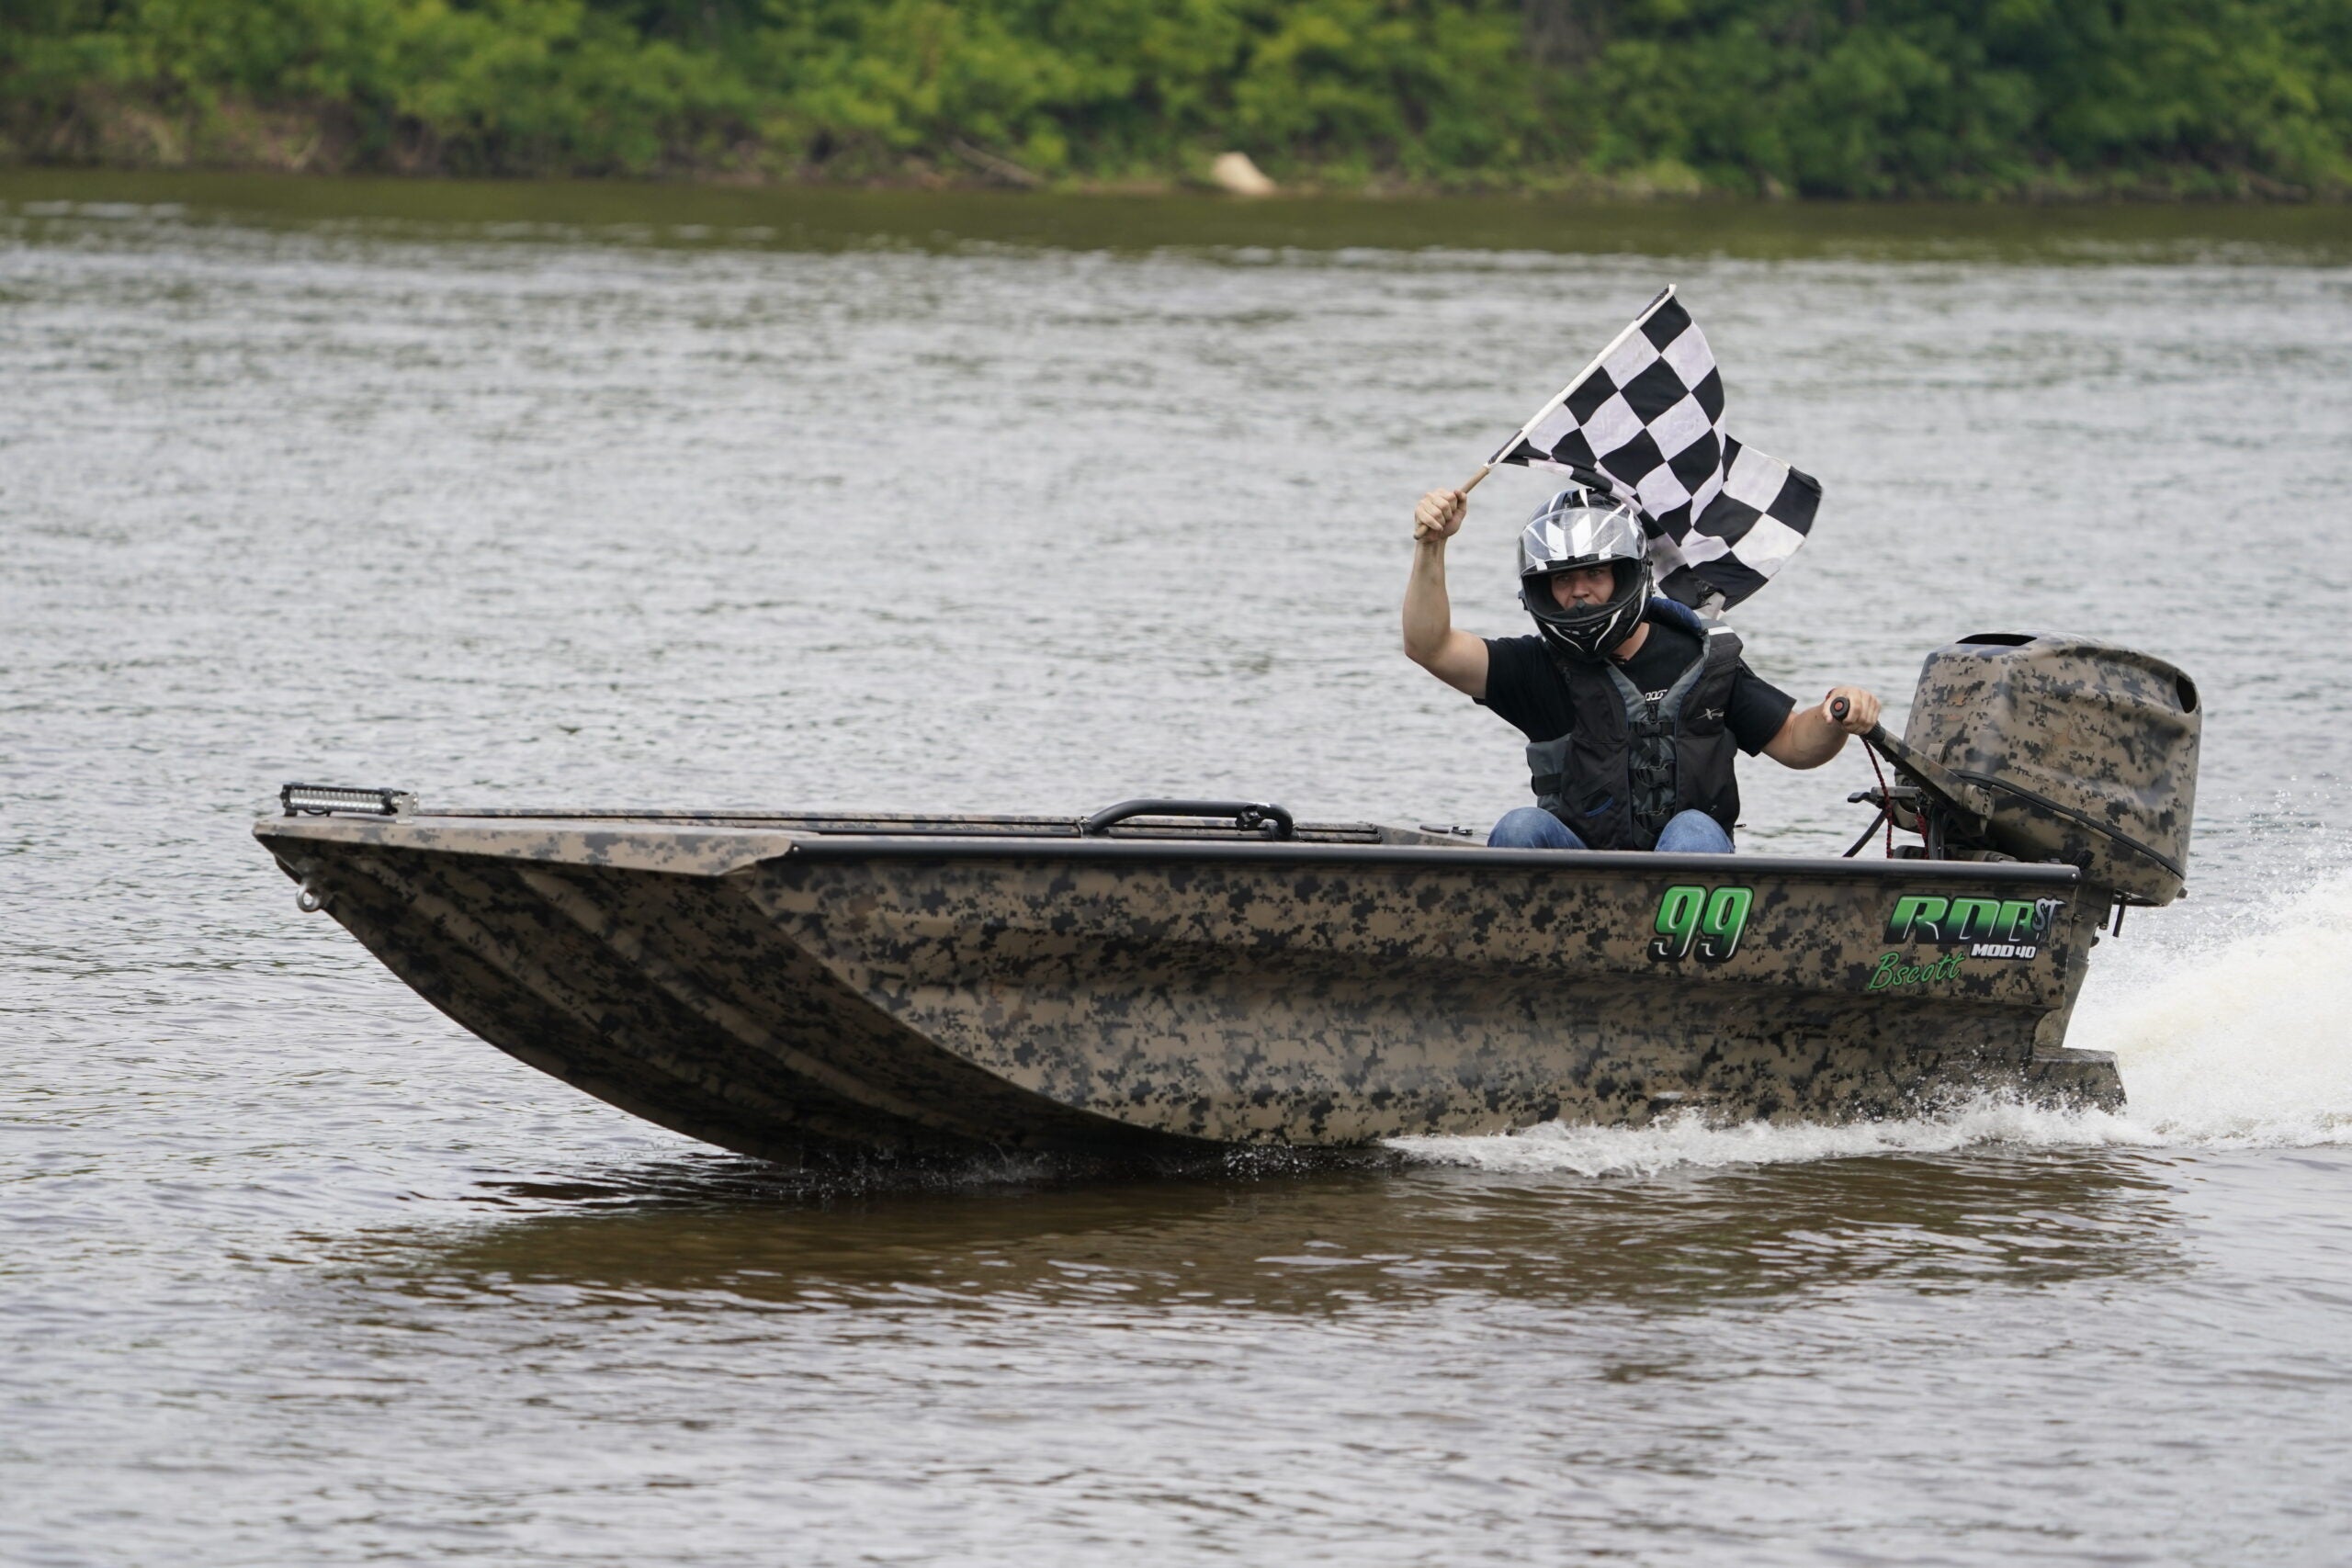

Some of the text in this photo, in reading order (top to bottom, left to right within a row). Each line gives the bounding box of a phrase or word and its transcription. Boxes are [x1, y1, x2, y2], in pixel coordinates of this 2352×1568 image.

[1647, 886, 1755, 963] 99
[1971, 943, 2037, 959] MOD 40
[1868, 952, 1965, 989] Bscott
